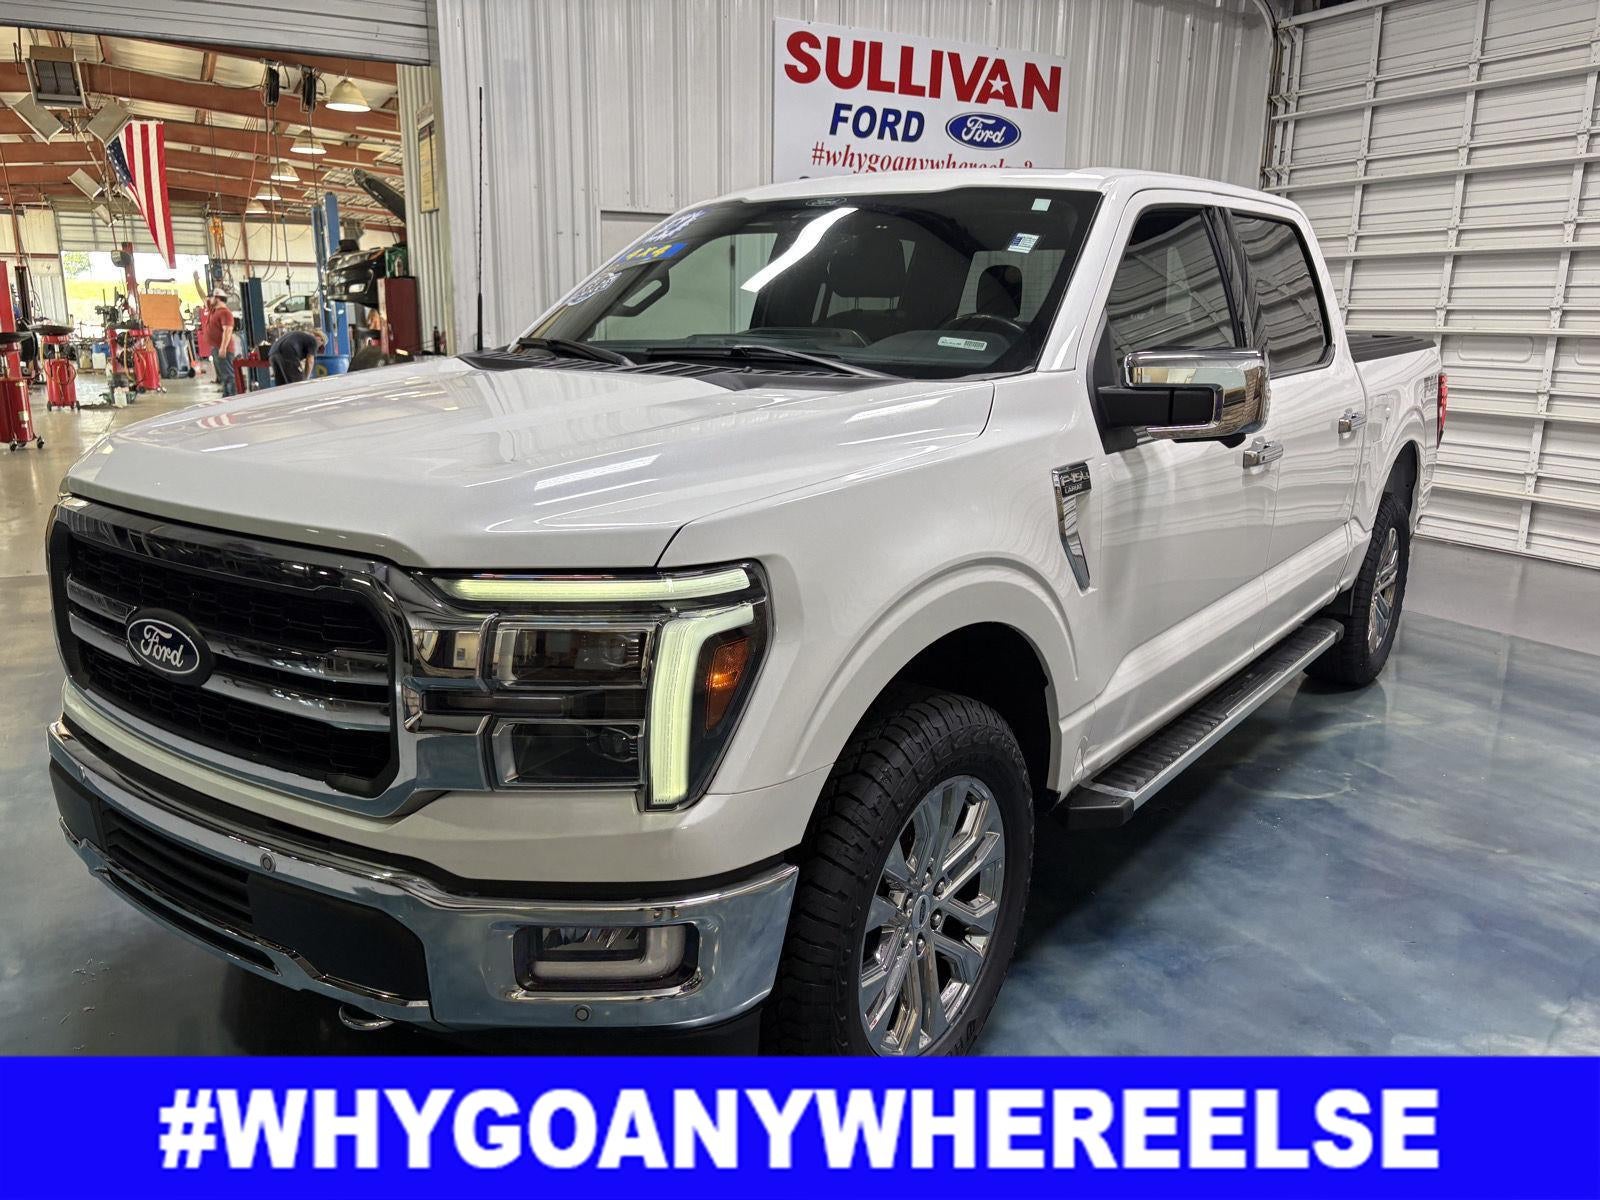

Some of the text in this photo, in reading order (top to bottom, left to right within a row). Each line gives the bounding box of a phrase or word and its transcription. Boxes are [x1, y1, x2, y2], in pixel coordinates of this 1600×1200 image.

[784, 31, 1061, 112] SULLIVAN
[829, 102, 925, 143] FORD
[962, 116, 1006, 144] Ford
[140, 624, 185, 668] Ford
